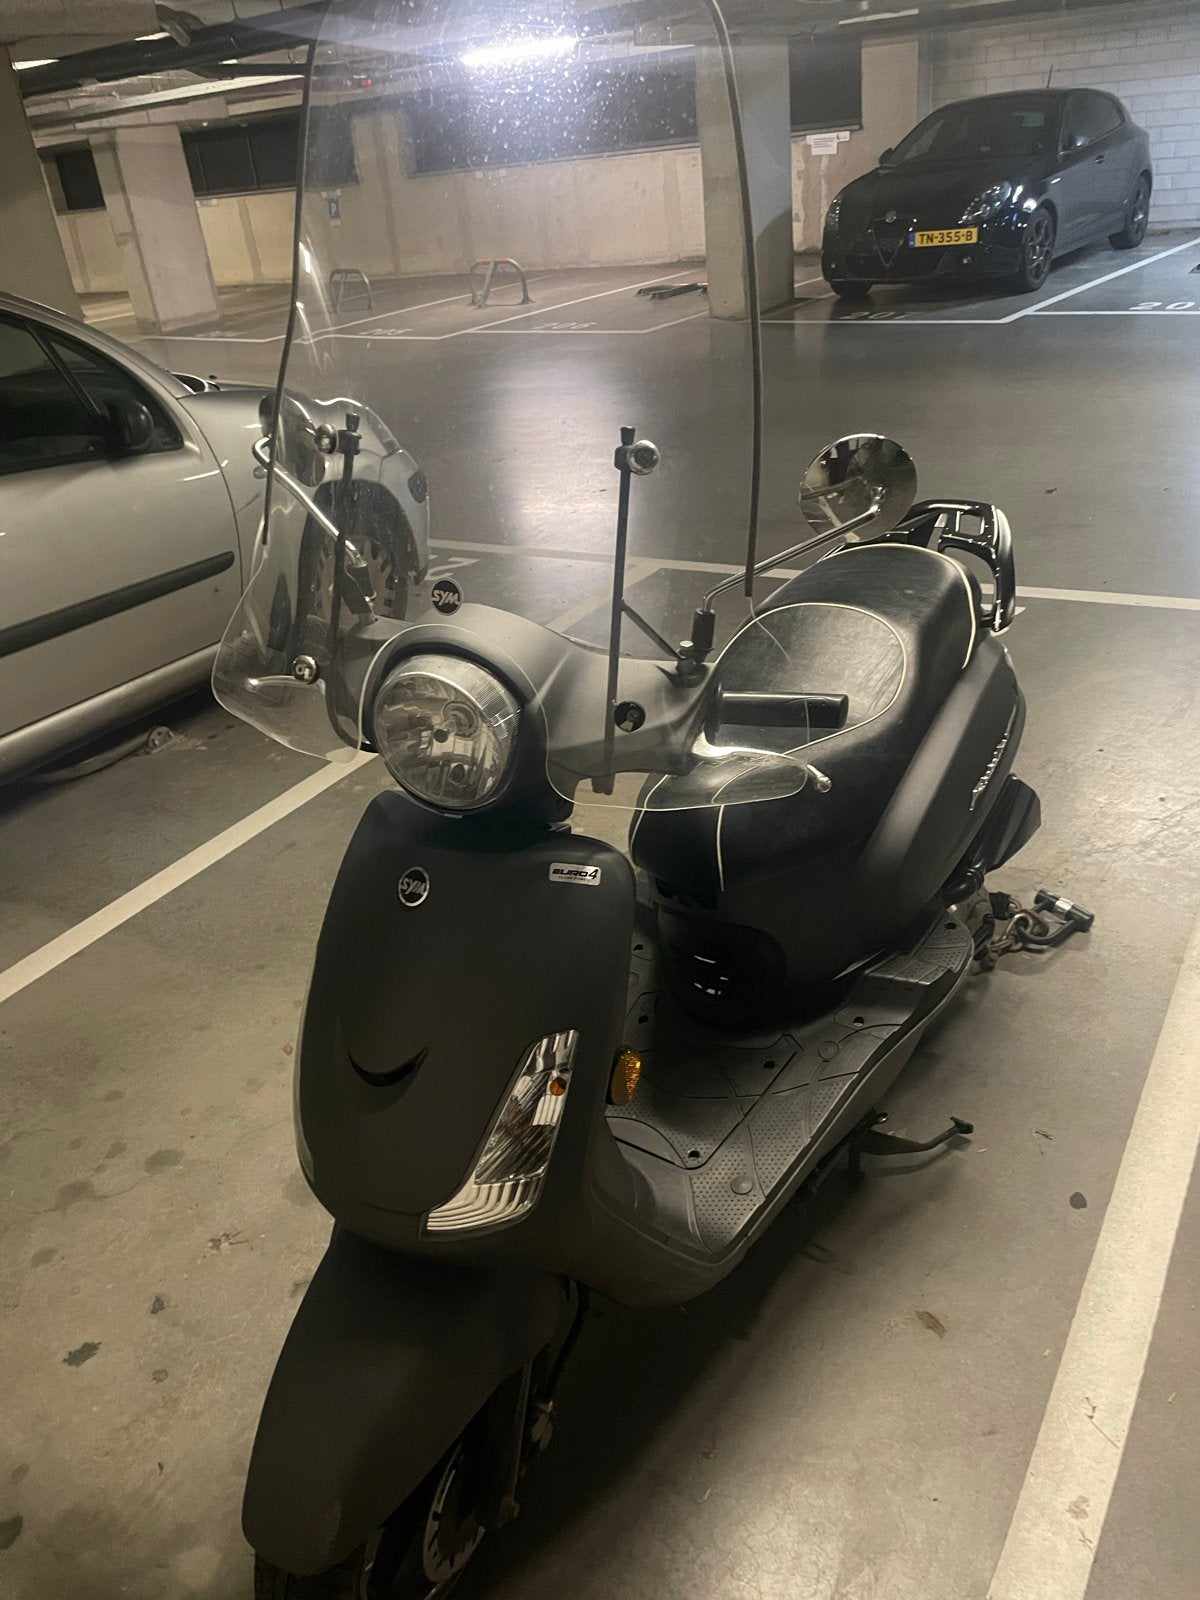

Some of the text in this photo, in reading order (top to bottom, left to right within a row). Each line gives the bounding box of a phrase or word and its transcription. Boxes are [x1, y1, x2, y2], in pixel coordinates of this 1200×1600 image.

[919, 230, 973, 245] TN-355-B
[1128, 301, 1200, 310] 20
[431, 590, 461, 606] SYM
[400, 877, 426, 895] SYM
